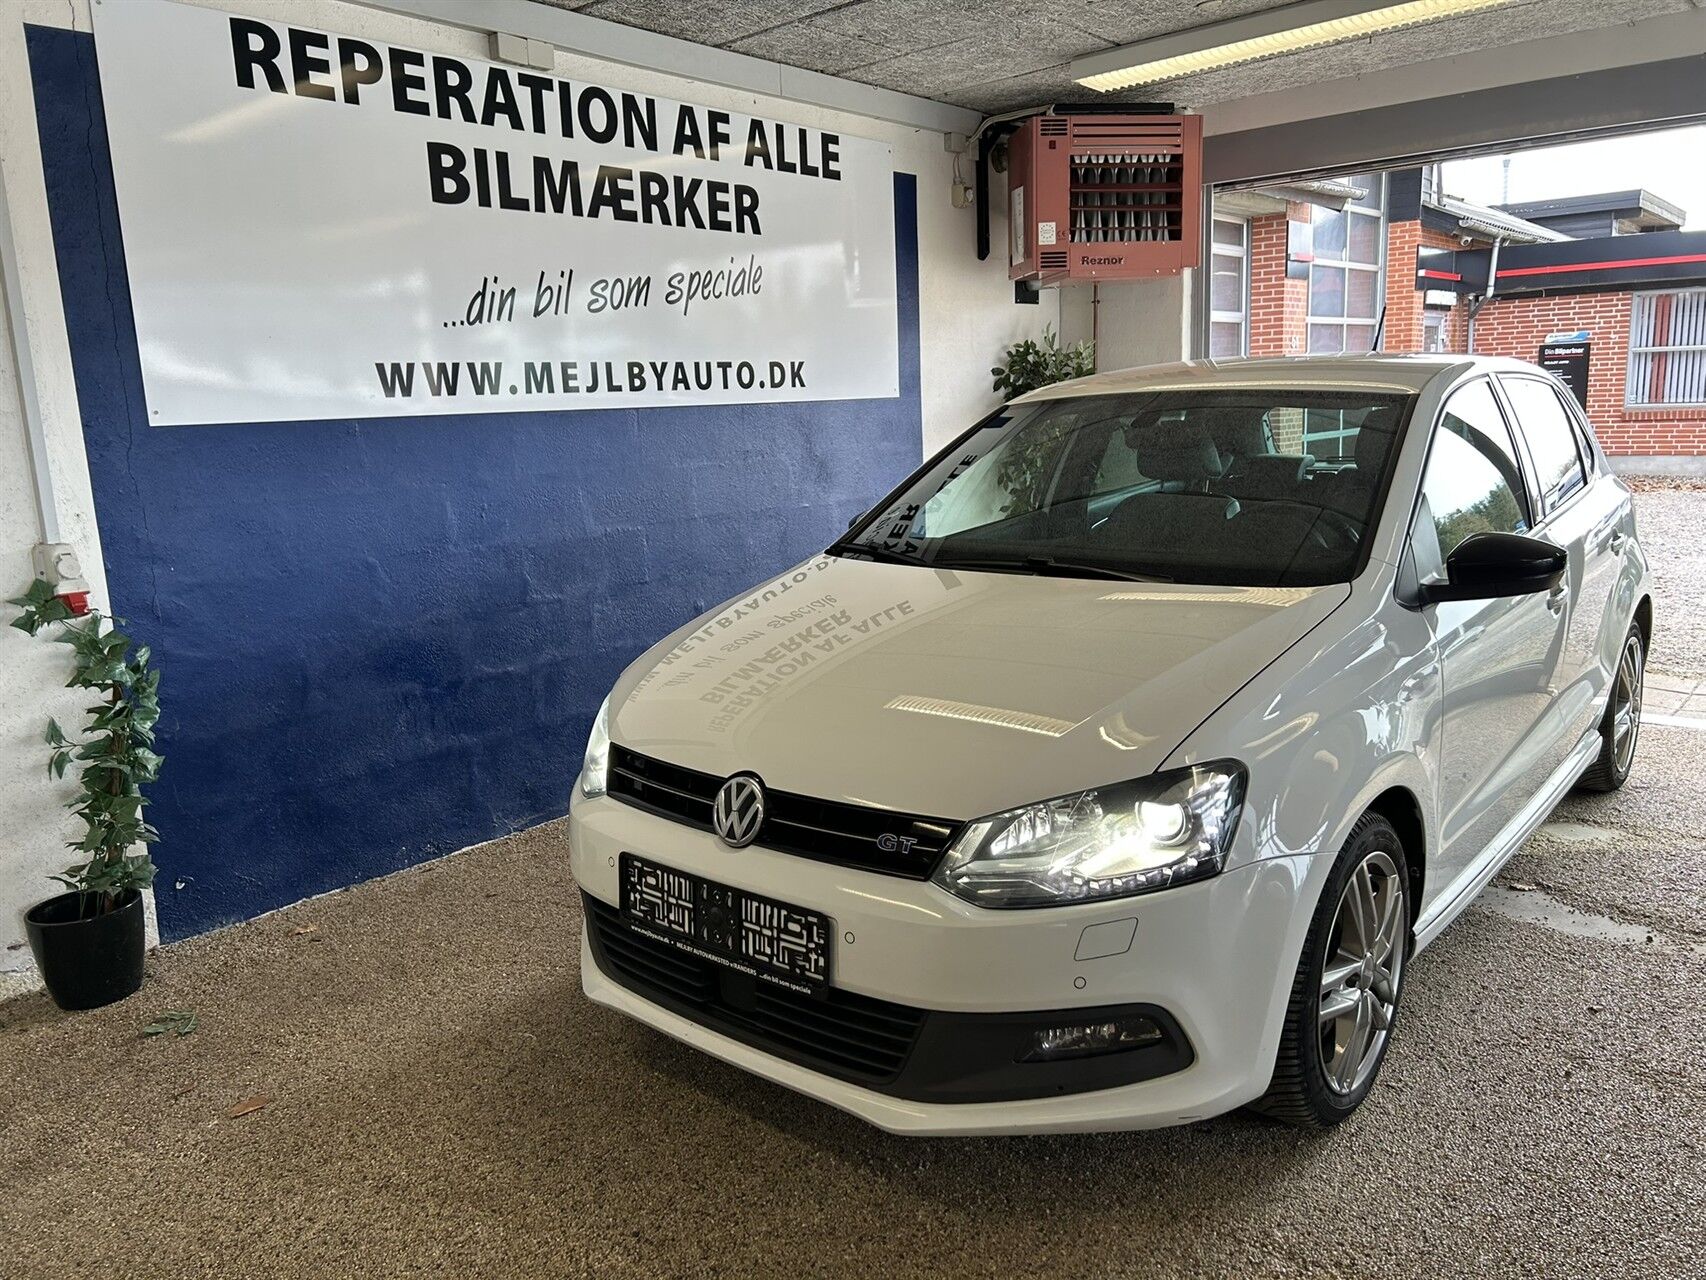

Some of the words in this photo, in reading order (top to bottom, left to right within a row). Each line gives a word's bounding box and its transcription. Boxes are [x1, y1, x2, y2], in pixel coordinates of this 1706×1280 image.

[229, 17, 659, 152] REPERATION
[672, 104, 731, 162] AF
[744, 118, 842, 181] ALLE
[426, 141, 762, 236] BILMÆRKER
[1081, 255, 1124, 265] Reznor
[443, 275, 517, 328] ...din
[532, 268, 574, 319] bil
[587, 275, 652, 314] som
[664, 254, 764, 317] speciale
[375, 361, 806, 397] WWW.MEJLBYAUTO.DK
[876, 833, 918, 854] GT
[771, 975, 779, 984] bil
[779, 979, 790, 988] som
[790, 983, 812, 995] speciale
